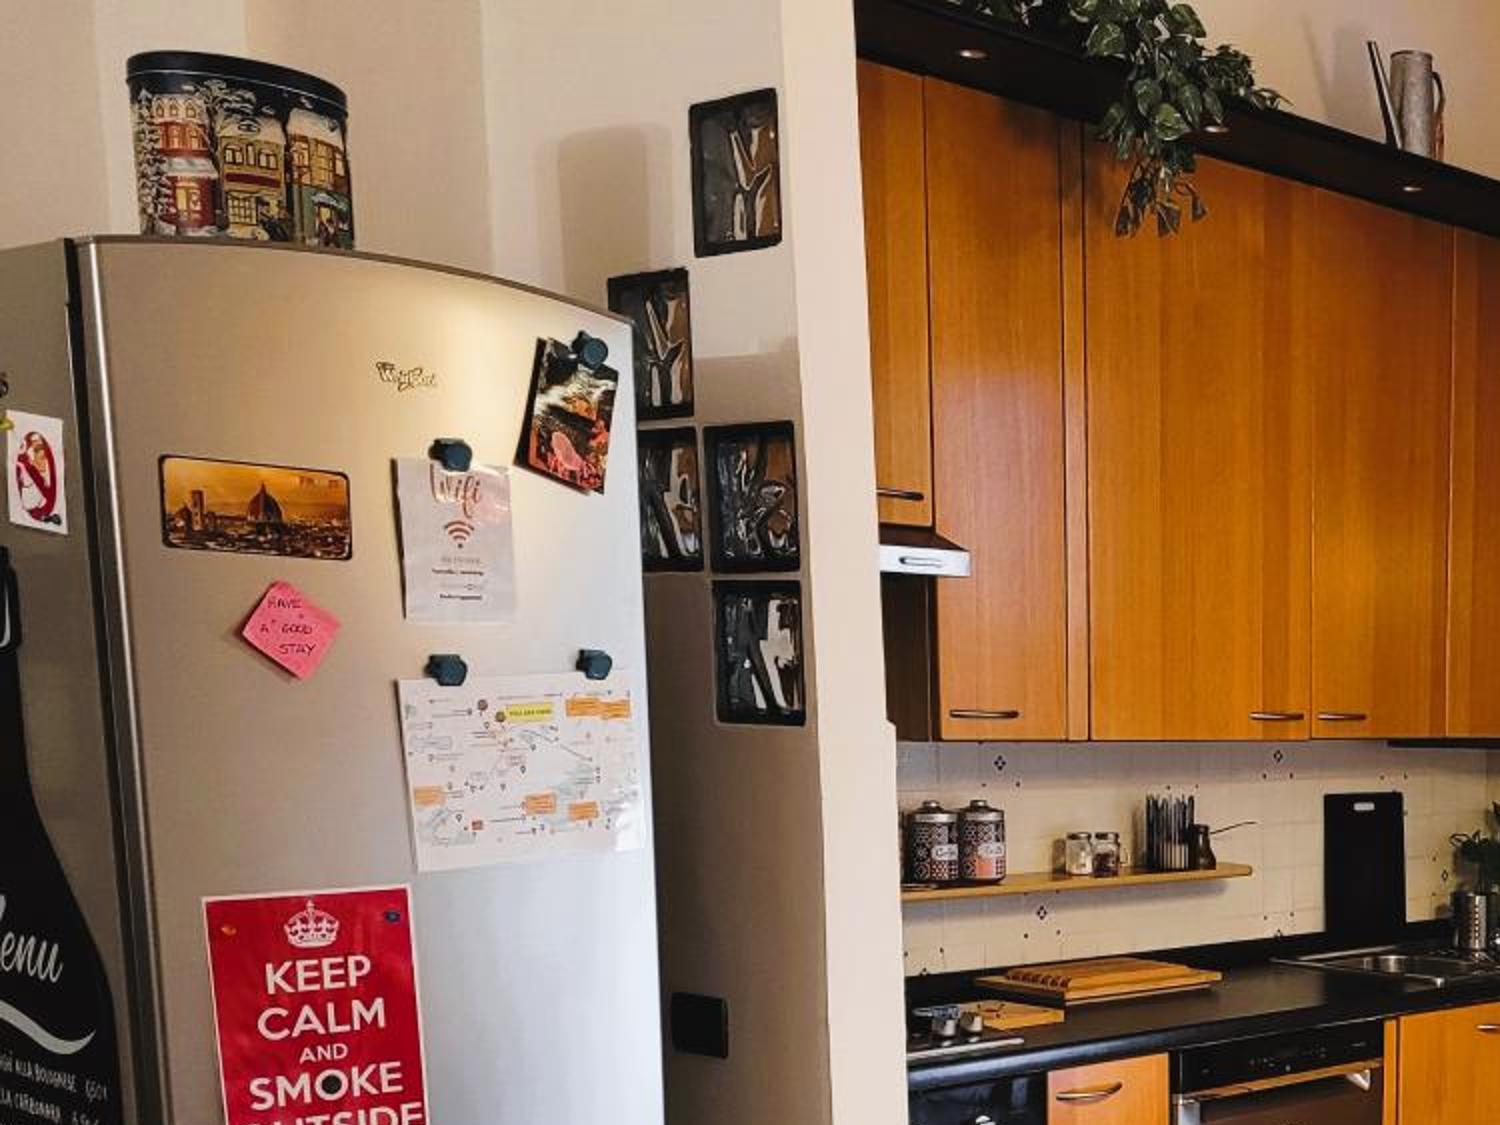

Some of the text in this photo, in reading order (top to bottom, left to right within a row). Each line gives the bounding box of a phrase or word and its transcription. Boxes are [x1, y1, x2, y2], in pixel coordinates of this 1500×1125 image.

[267, 598, 303, 609] HAVE
[281, 624, 313, 635] GOOD
[279, 643, 317, 656] STAY
[265, 954, 371, 995] KEEP
[258, 997, 386, 1041] CALM
[299, 1043, 348, 1064] AND
[250, 1062, 403, 1111] SMOKE
